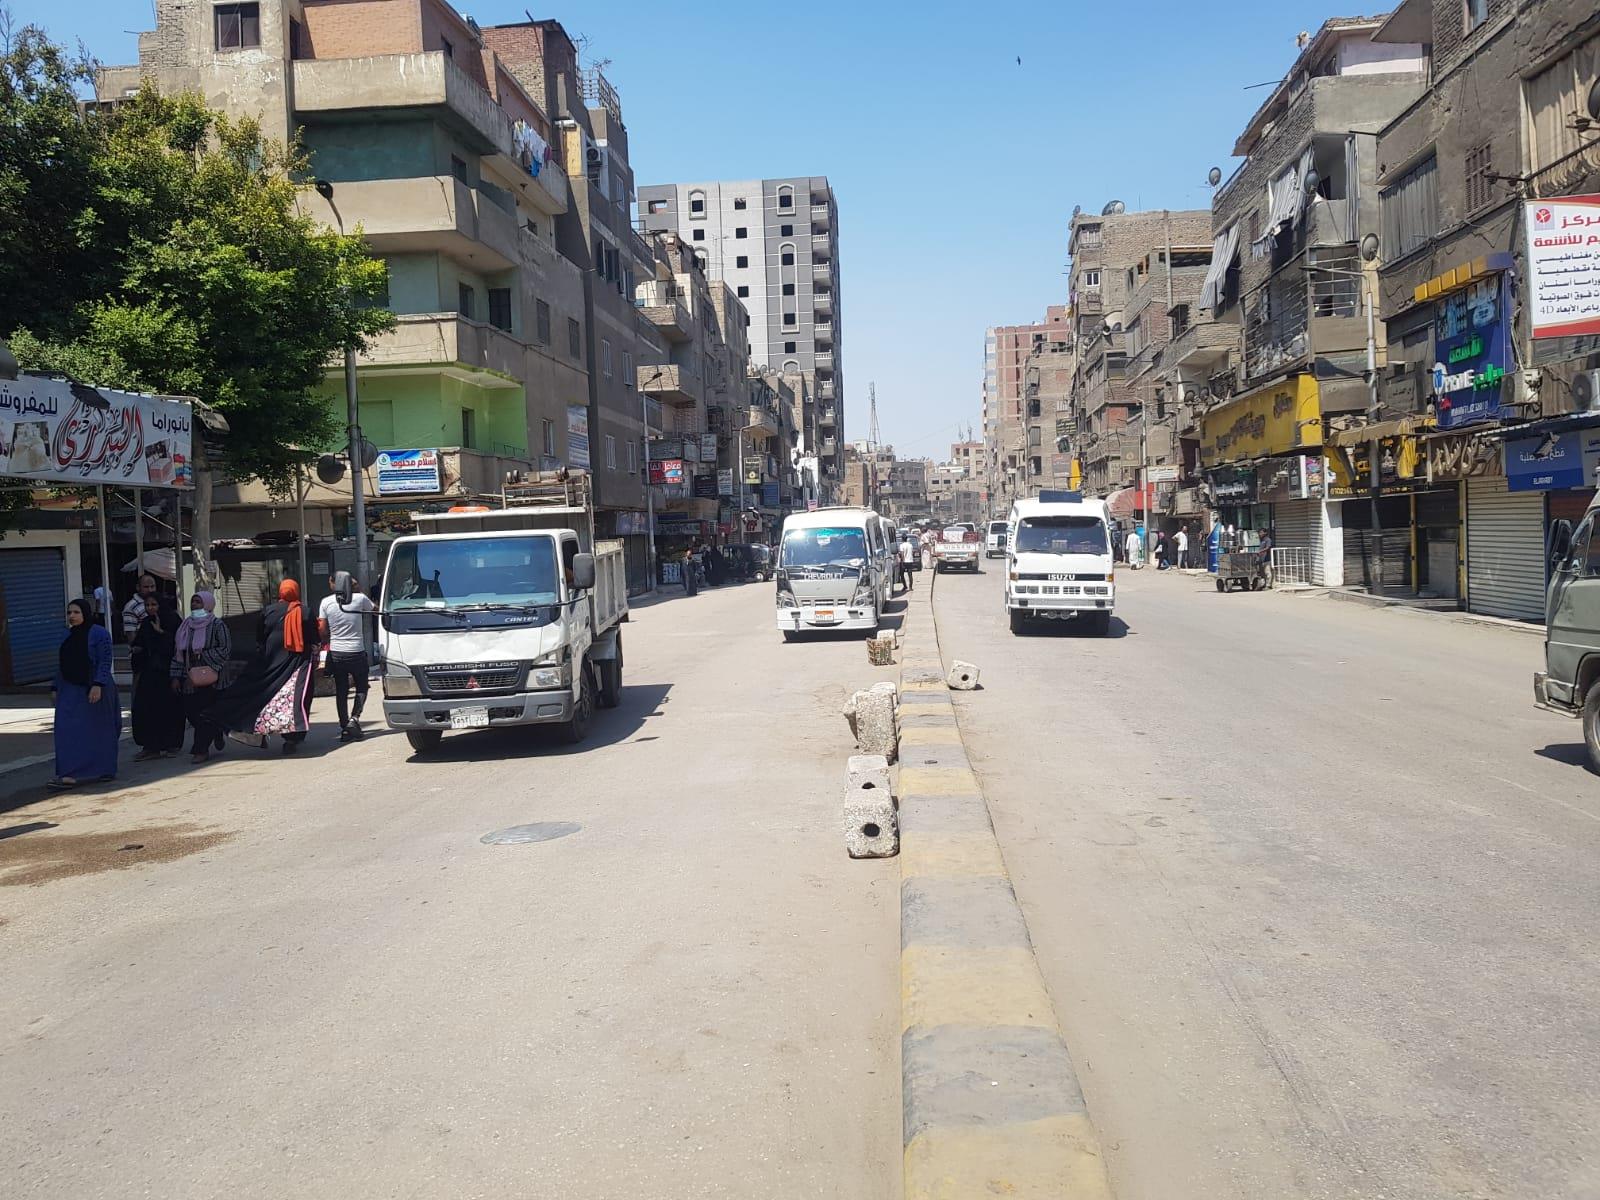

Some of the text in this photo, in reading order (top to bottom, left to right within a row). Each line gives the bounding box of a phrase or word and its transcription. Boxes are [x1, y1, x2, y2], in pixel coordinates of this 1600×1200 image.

[1534, 233, 1583, 247] للأشعة
[152, 411, 190, 434] بانوراما
[1519, 451, 1536, 464] صلية
[424, 663, 486, 671] MITSUBISHI
